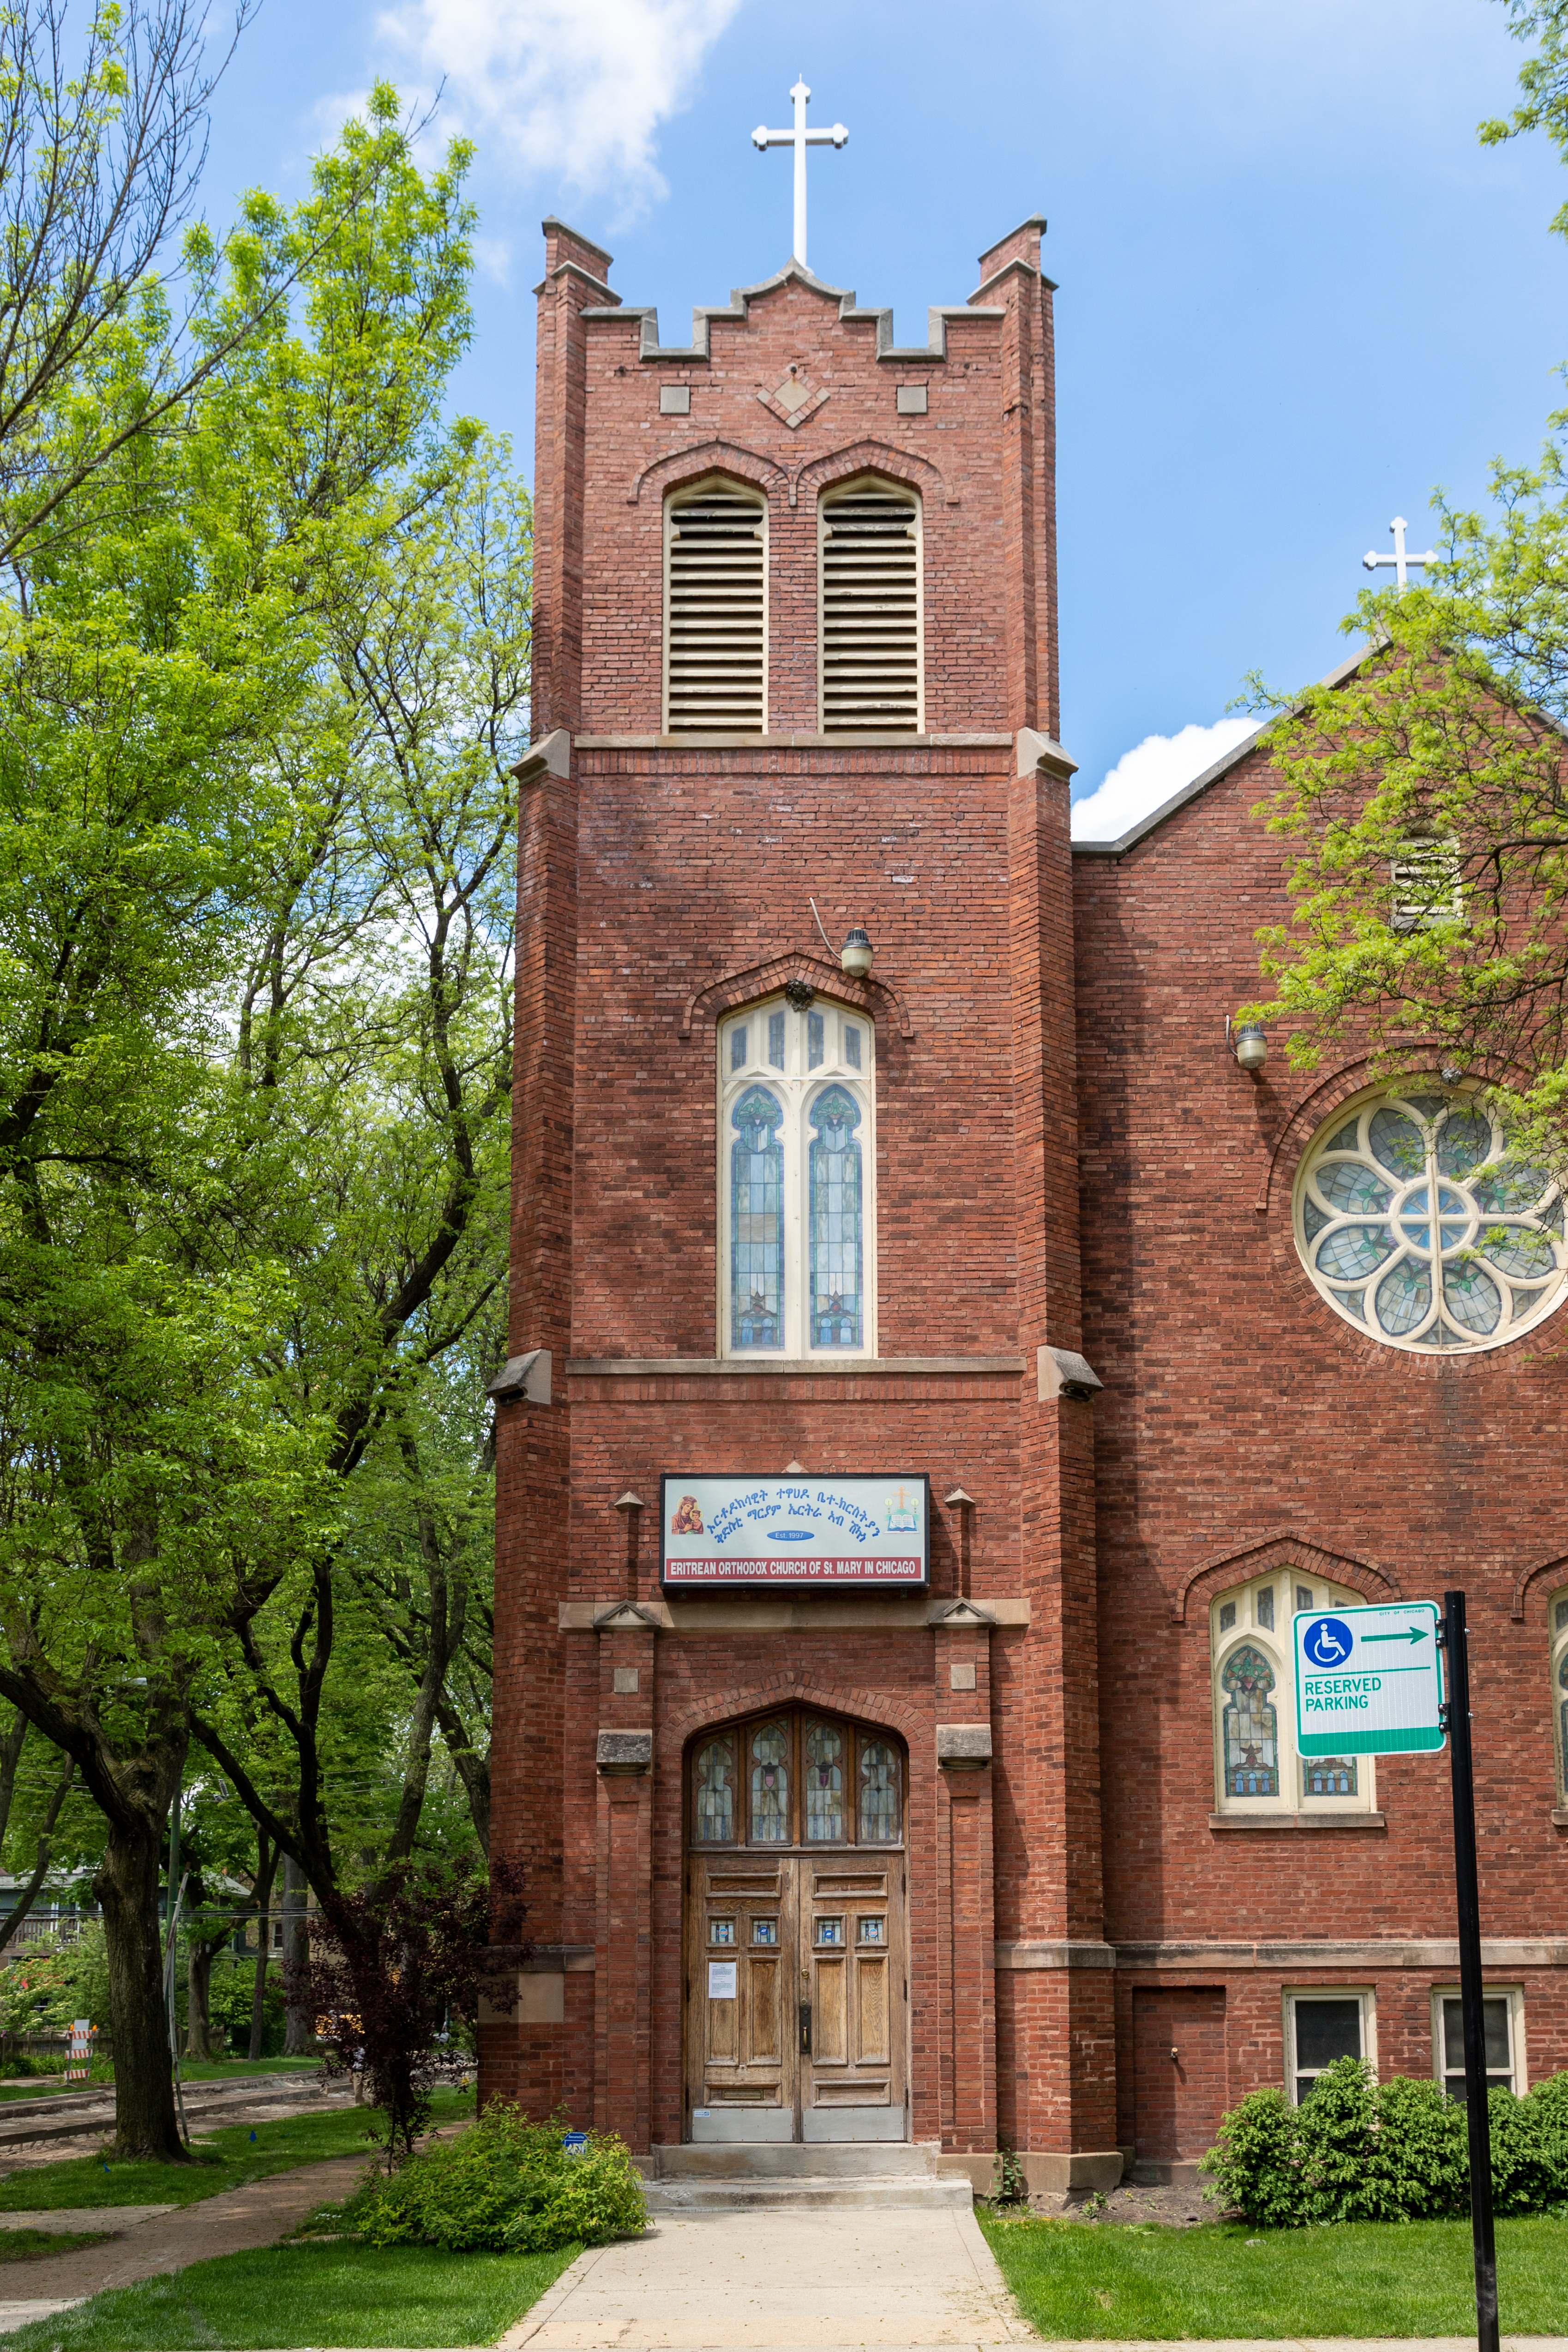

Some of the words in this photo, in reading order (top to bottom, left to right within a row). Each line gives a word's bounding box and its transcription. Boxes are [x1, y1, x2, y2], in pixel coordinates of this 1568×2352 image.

[671, 1562, 715, 1575] ERITREAN
[718, 1561, 767, 1575] ORTHODOX
[770, 1561, 807, 1575] CHURCH
[809, 1561, 821, 1575] OF
[823, 1561, 835, 1575] St.
[836, 1561, 862, 1574] MARY
[864, 1561, 874, 1574] IN
[876, 1560, 915, 1574] CHICAGO
[1305, 1677, 1382, 1695] RESERVED
[1305, 1695, 1369, 1712] PARKING
[725, 1900, 763, 1914] 6350
